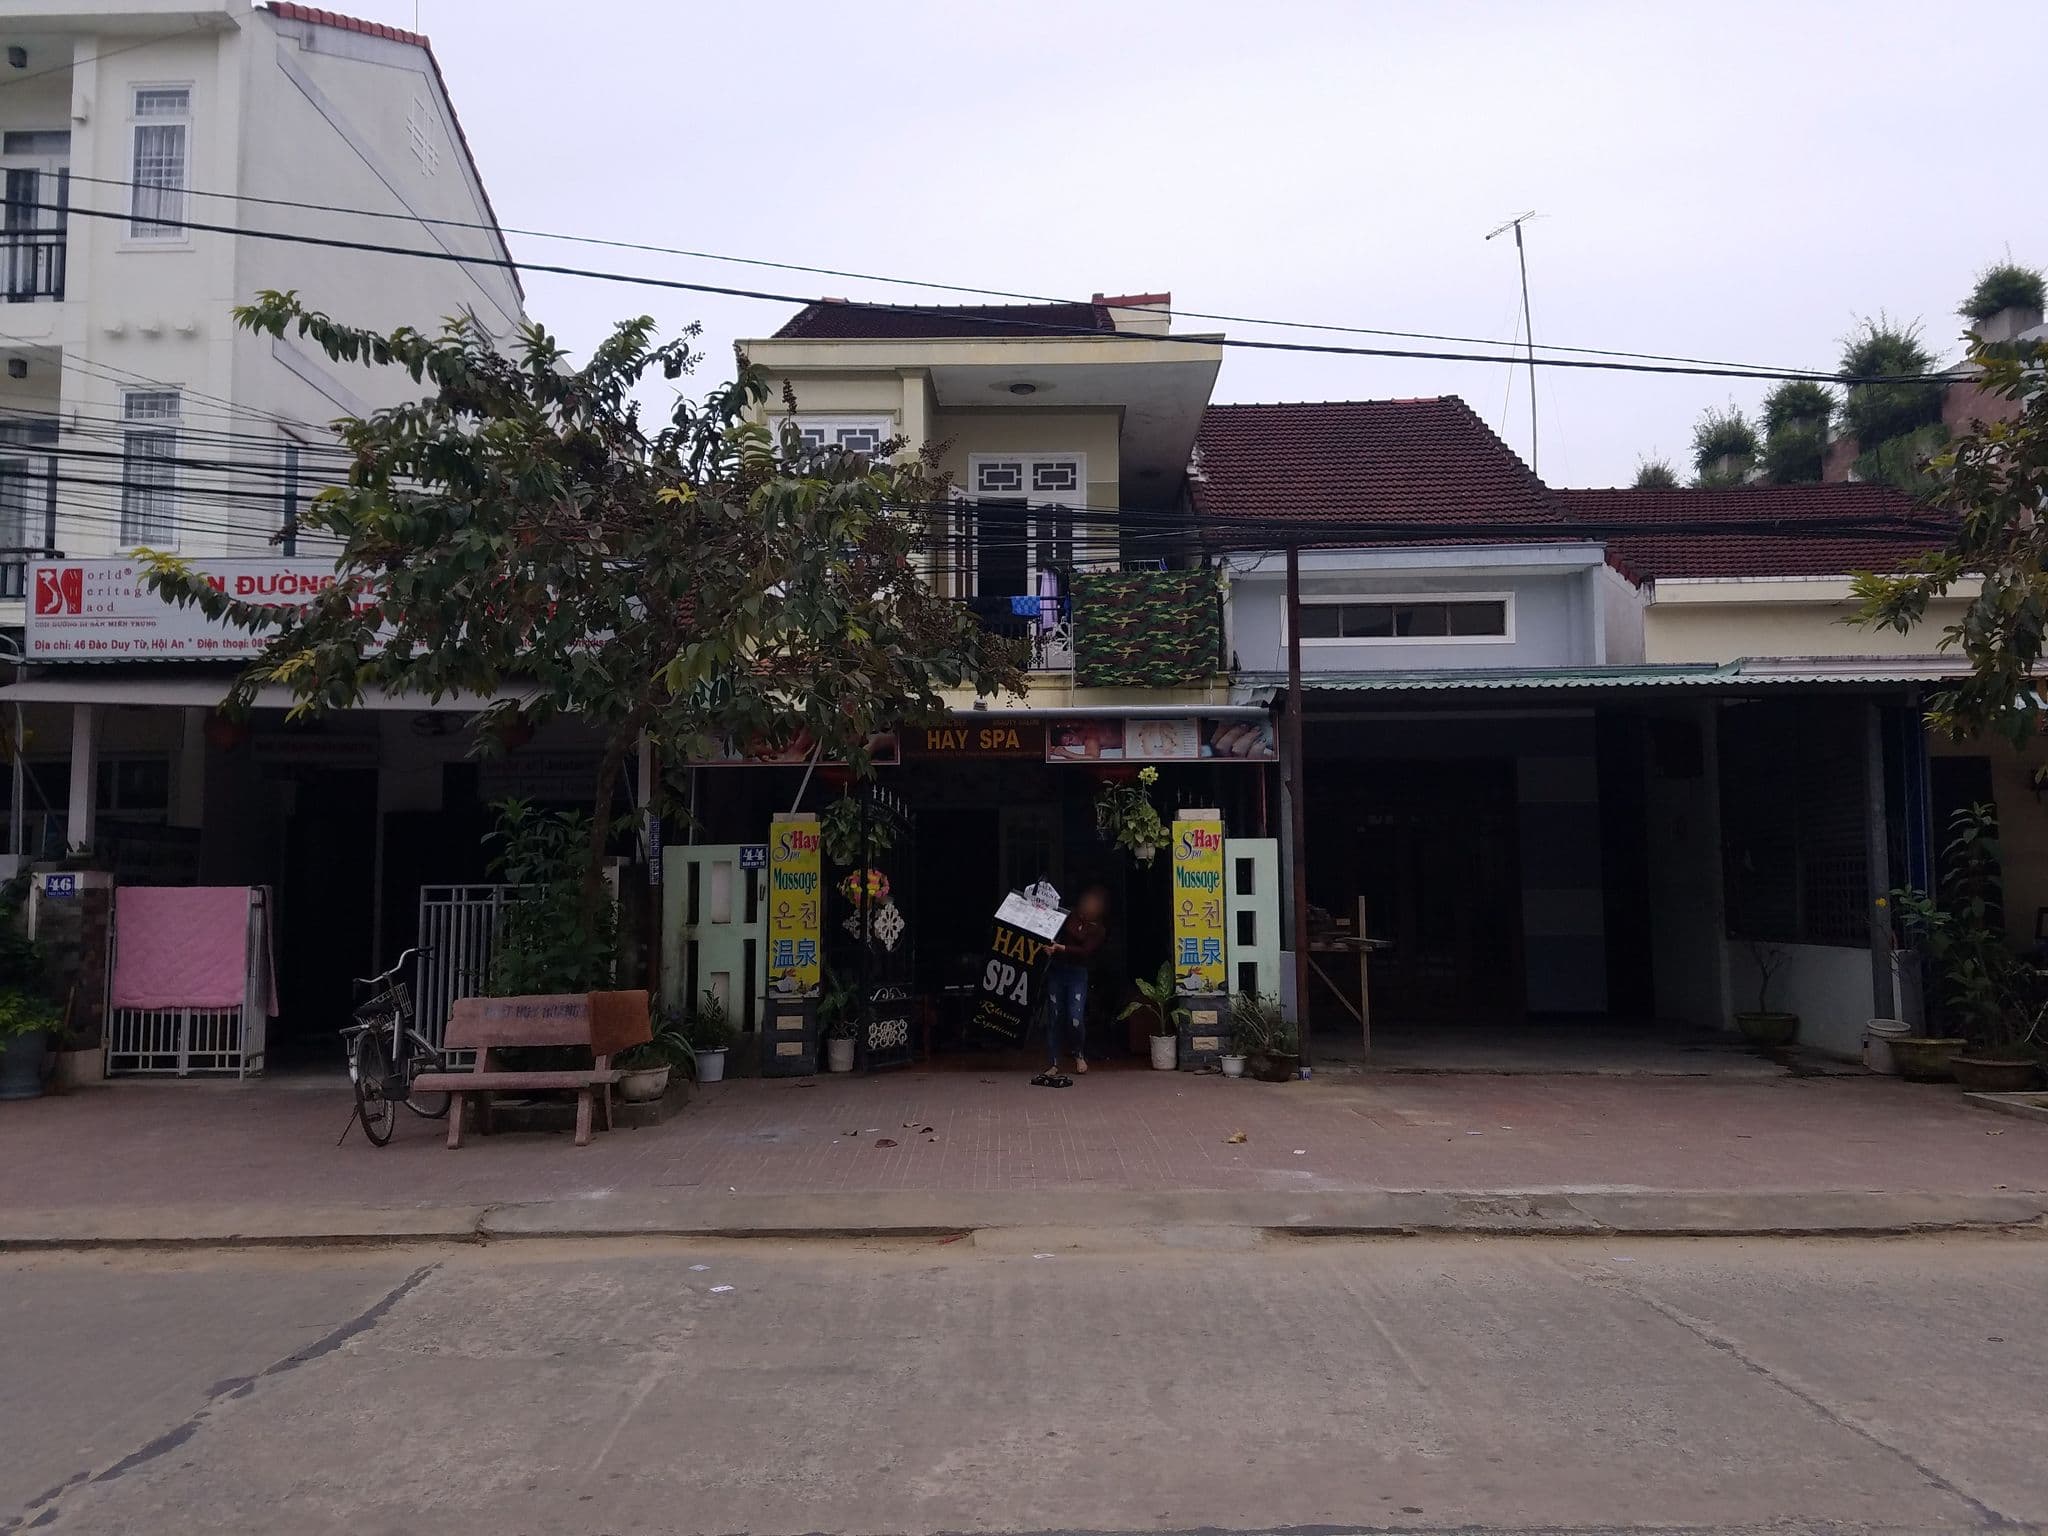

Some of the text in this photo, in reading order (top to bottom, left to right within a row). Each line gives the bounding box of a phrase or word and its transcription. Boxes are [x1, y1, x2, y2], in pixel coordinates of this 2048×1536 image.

[35, 640, 51, 652] Địa
[74, 640, 86, 650] 46
[88, 640, 108, 651] Đào
[111, 640, 130, 652] Duy
[151, 638, 168, 652] Hội
[171, 639, 185, 650] An
[197, 638, 219, 651] Điện
[926, 727, 1020, 750] HAY SPA
[792, 831, 820, 852] Hay
[1193, 829, 1221, 851] Hay
[742, 848, 765, 861] 44
[48, 878, 72, 891] 46
[773, 867, 818, 895] Massage
[1176, 866, 1221, 894] Massage
[772, 900, 818, 931] 온천
[1176, 899, 1222, 930] 온천
[772, 938, 818, 970] 温泉
[992, 927, 1044, 965] HAY
[1176, 937, 1223, 967] 温泉
[982, 959, 1028, 1006] SPA
